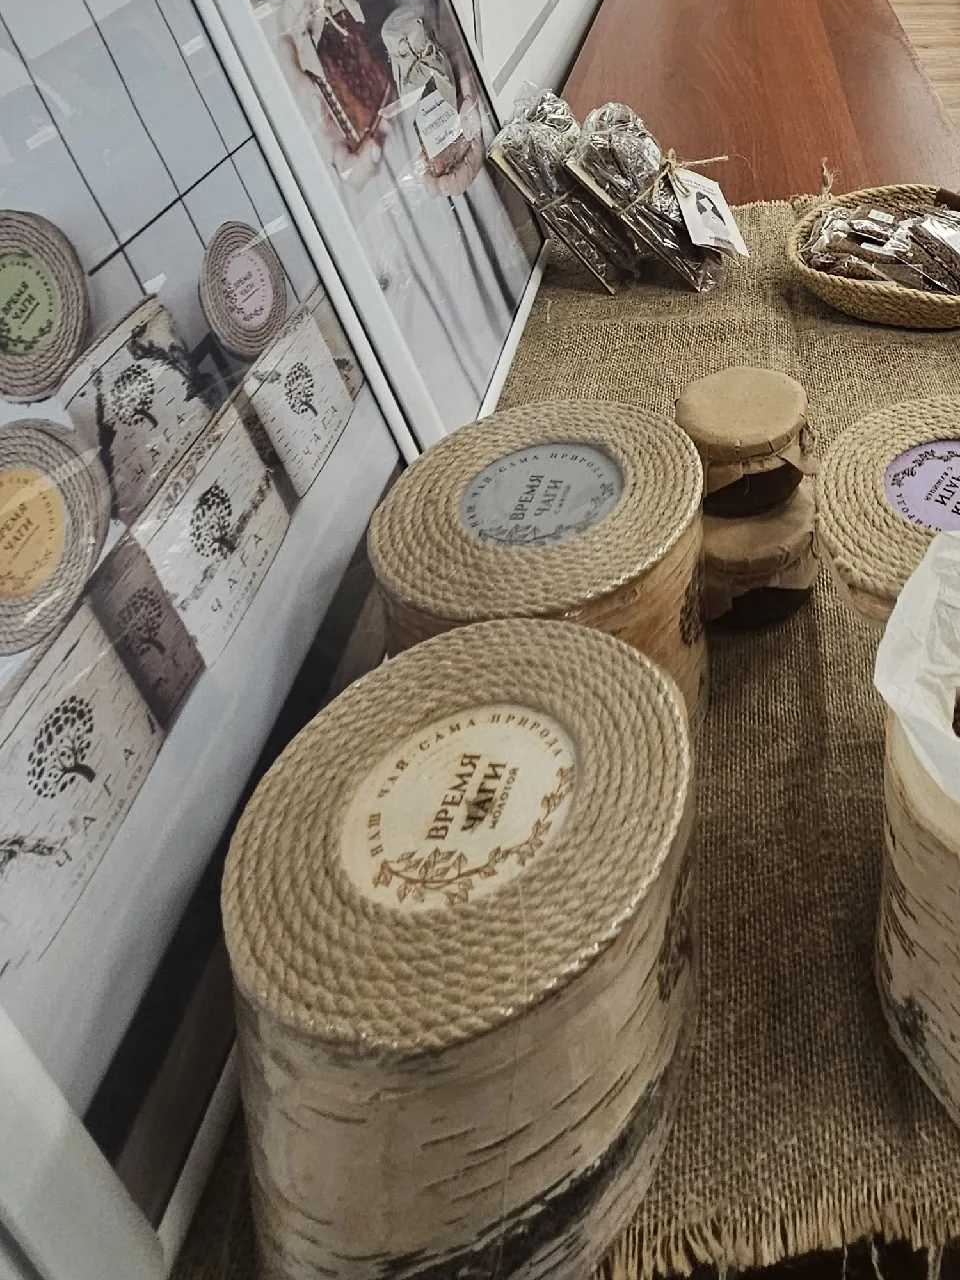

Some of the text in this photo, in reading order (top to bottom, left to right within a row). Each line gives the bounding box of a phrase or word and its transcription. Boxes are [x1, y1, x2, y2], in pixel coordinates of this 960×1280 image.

[509, 474, 546, 521] ВРЕМЯ
[534, 479, 564, 517] ЧАГИ
[368, 812, 384, 858] НАШ
[419, 718, 476, 752] САМА
[491, 714, 564, 757] ПРИРОДА
[425, 753, 482, 841] ВРЕМЯ
[460, 761, 508, 832] ЧАГИ
